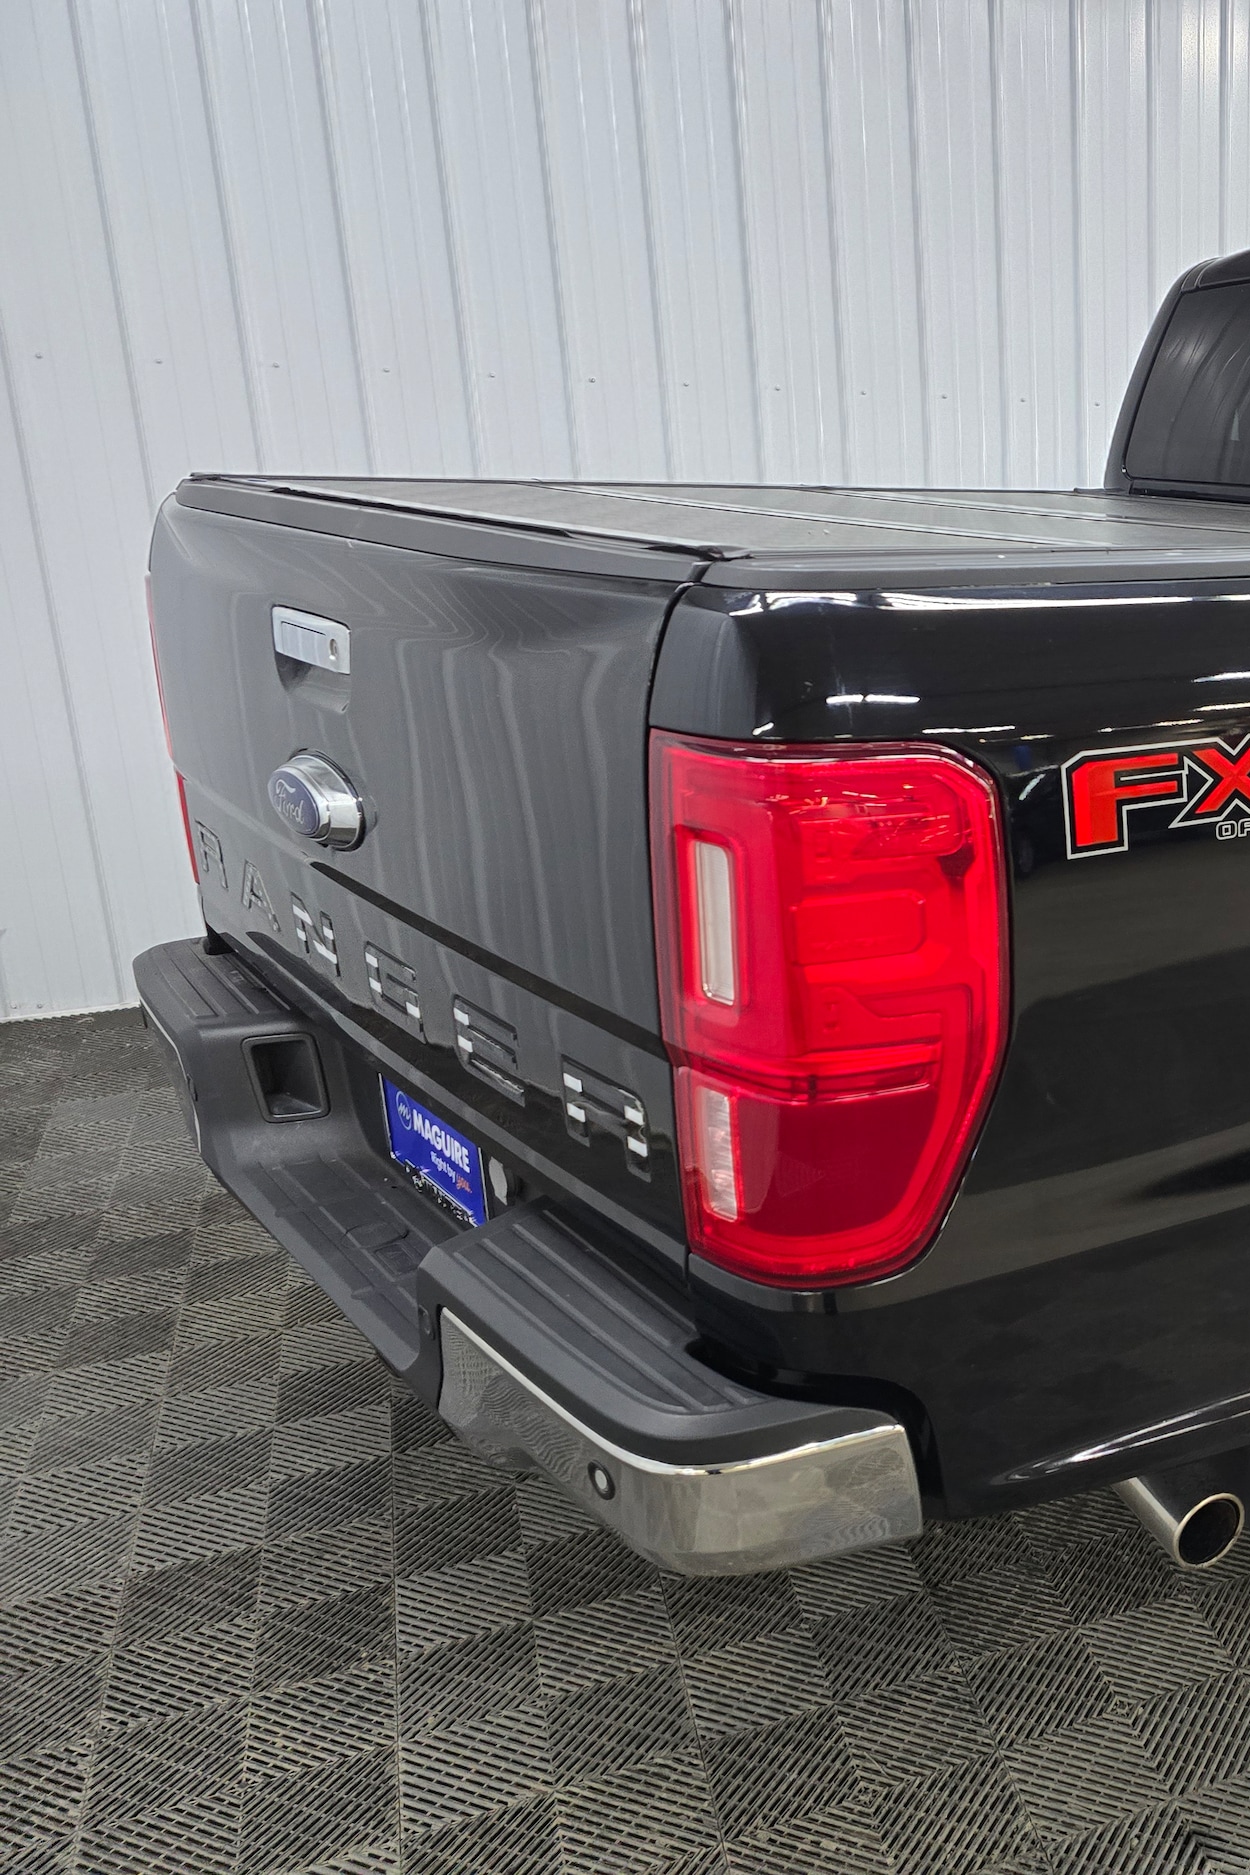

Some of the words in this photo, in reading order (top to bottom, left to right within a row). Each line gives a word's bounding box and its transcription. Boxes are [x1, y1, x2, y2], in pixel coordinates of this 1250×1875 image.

[274, 778, 305, 825] Ford
[195, 820, 652, 1182] RANGER
[412, 1108, 471, 1174] MAGUIRE
[431, 1150, 448, 1172] Right
[446, 1163, 456, 1183] by
